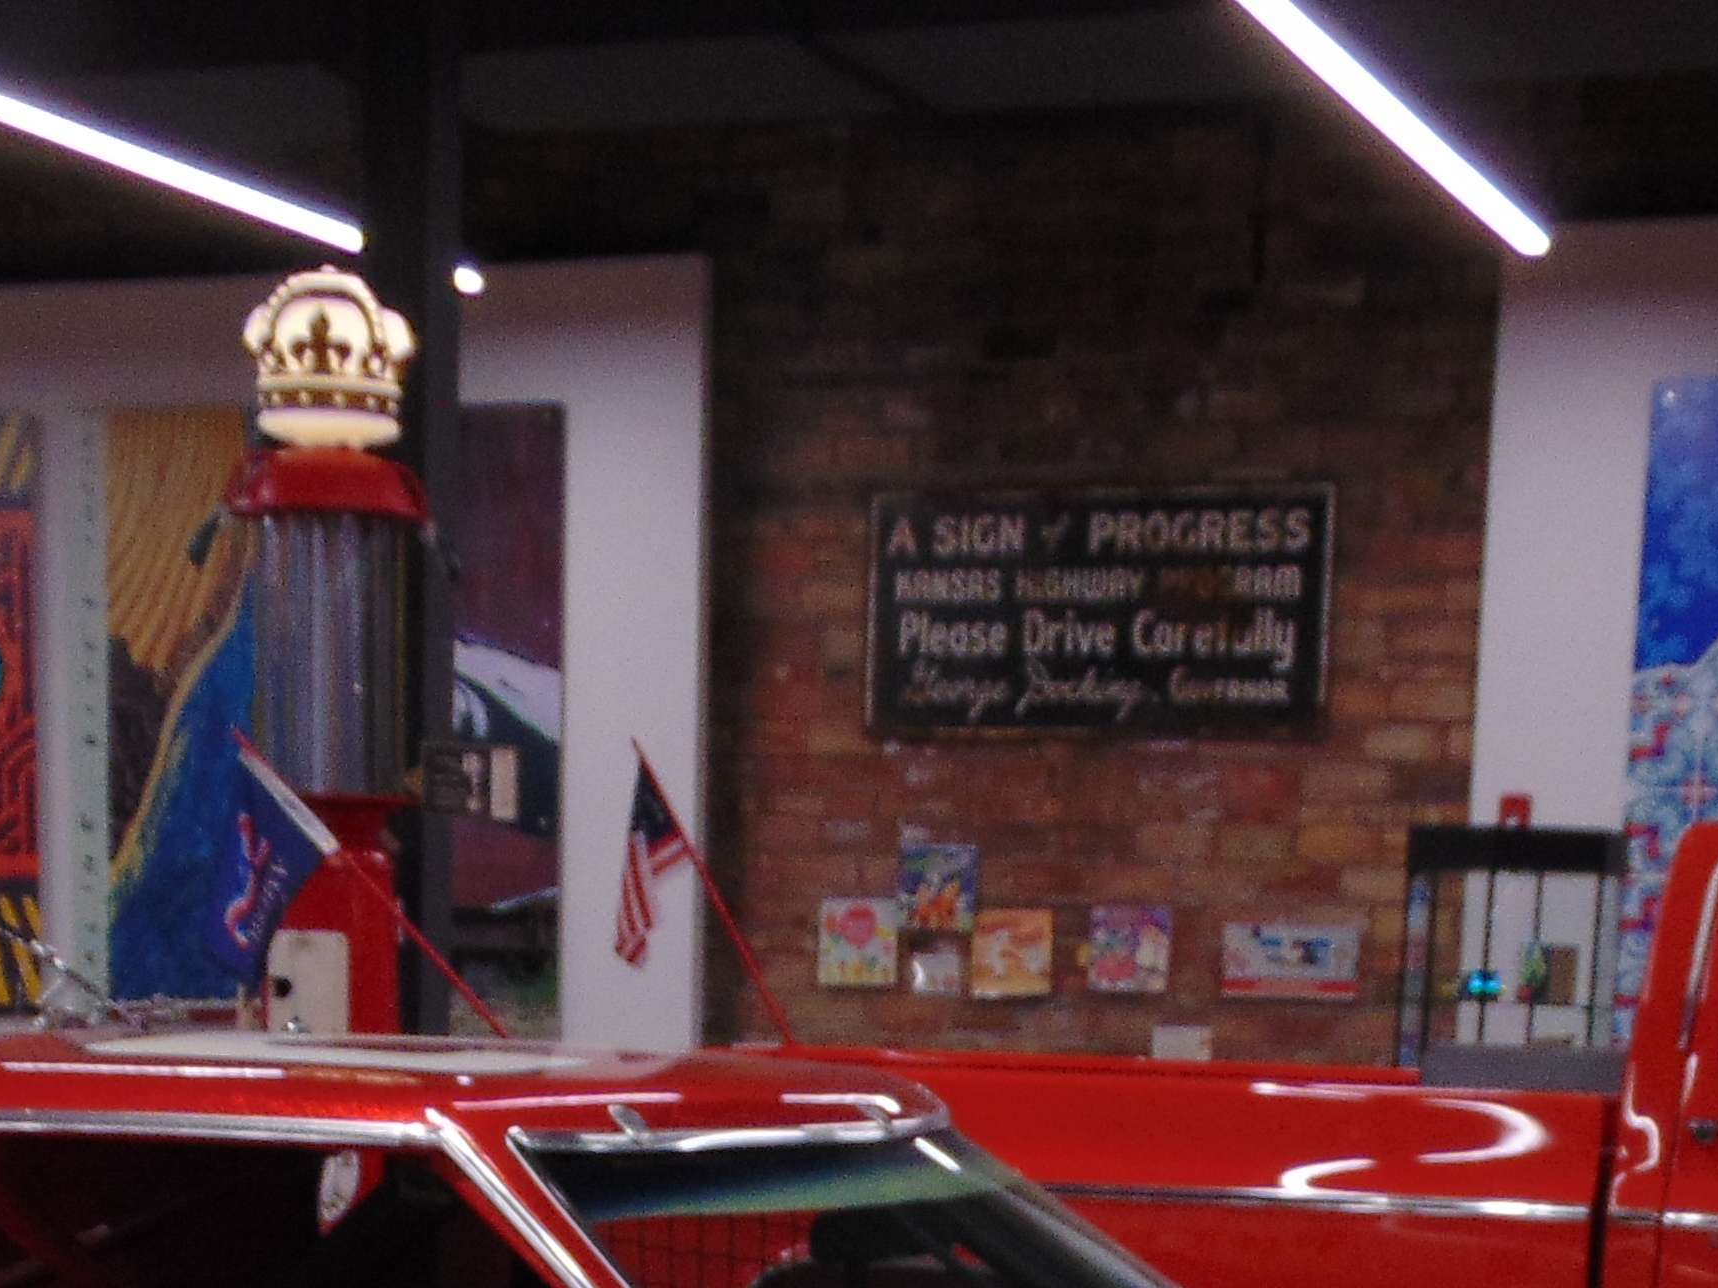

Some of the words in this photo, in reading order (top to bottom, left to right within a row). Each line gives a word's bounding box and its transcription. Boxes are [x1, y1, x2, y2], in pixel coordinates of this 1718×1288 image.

[888, 514, 918, 554] A
[930, 512, 1028, 556] SIGN
[1088, 508, 1311, 555] PROGRESS
[897, 611, 1008, 656] Please
[1021, 607, 1118, 657] Drive
